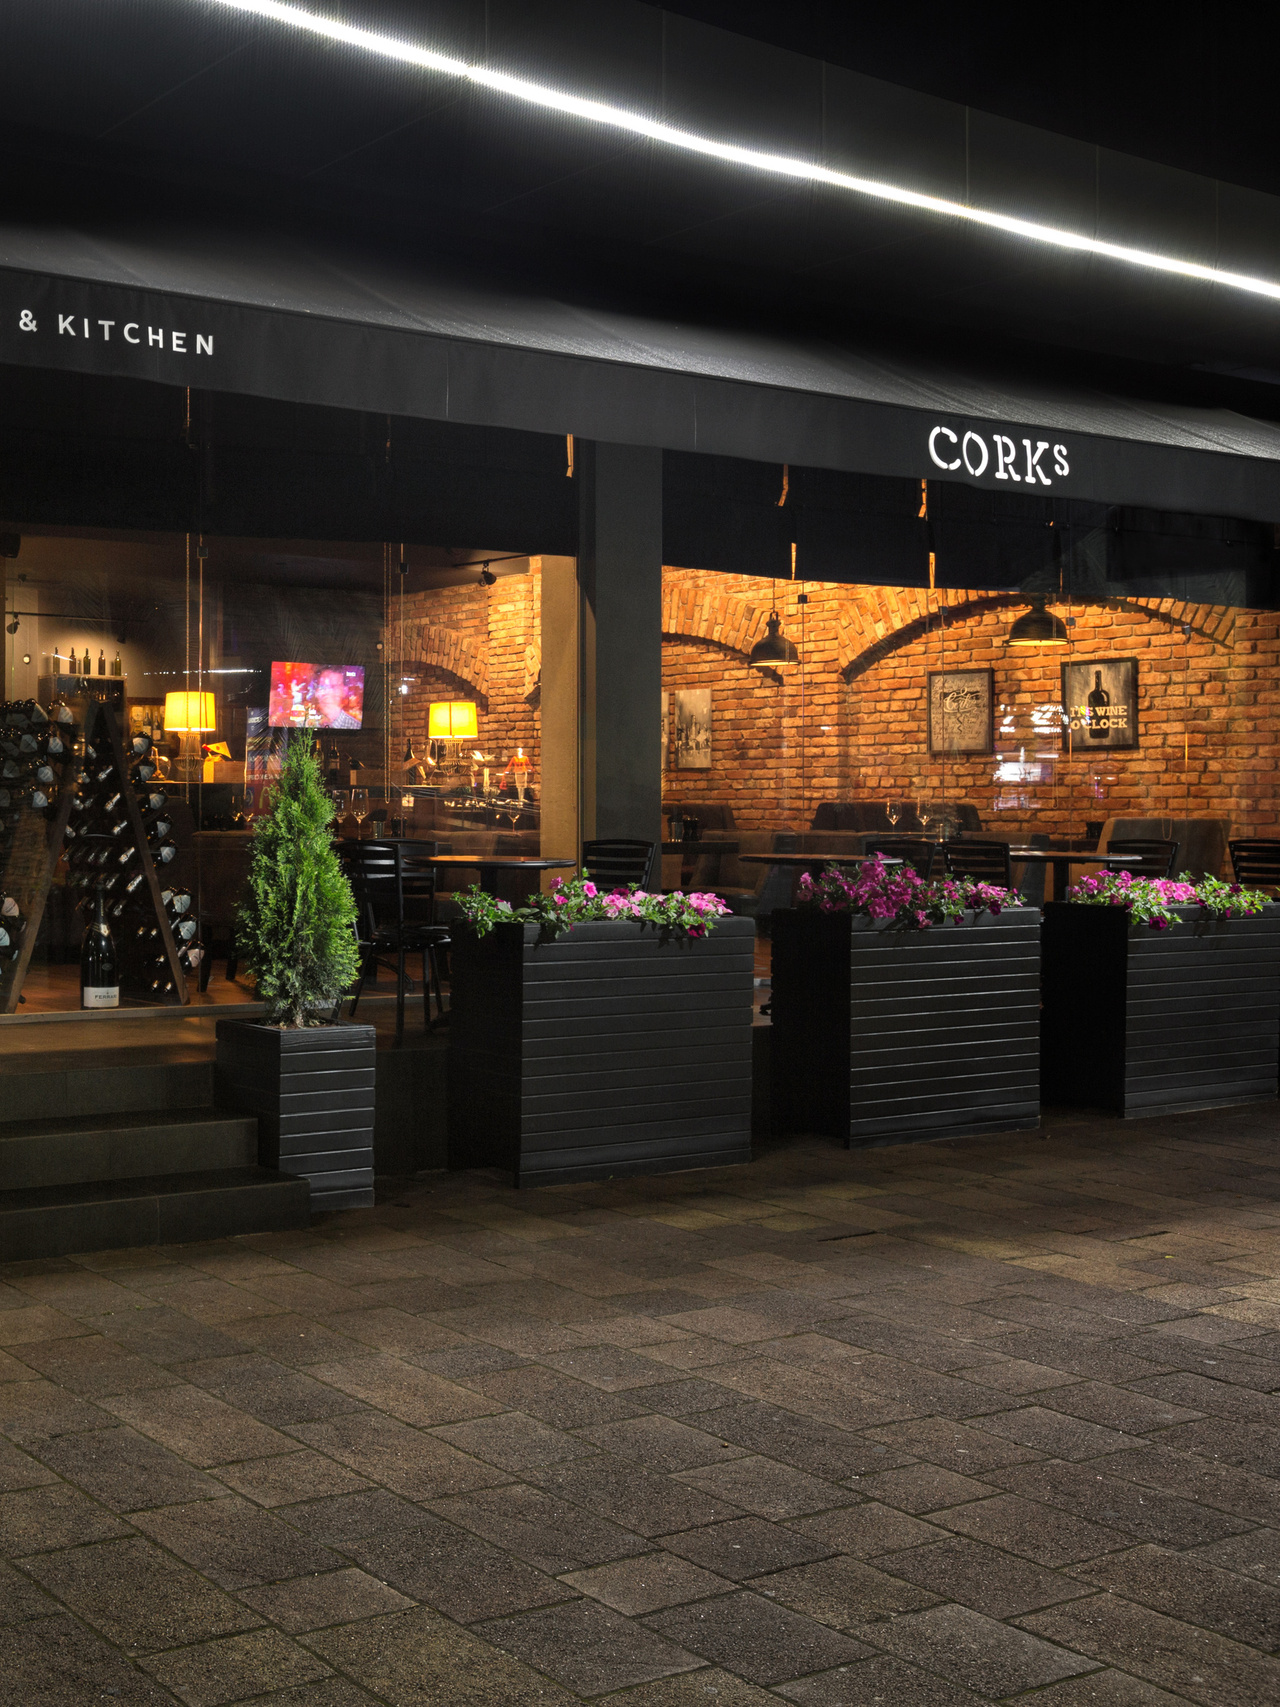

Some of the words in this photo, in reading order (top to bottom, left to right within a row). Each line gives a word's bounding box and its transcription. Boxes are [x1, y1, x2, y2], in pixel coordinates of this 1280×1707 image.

[18, 308, 38, 333] &
[57, 313, 215, 356] KITCHEN
[927, 425, 1070, 486] CORKS
[1070, 706, 1094, 717] ITS
[1095, 705, 1128, 716] WINE
[1070, 718, 1128, 730] OCLOCK
